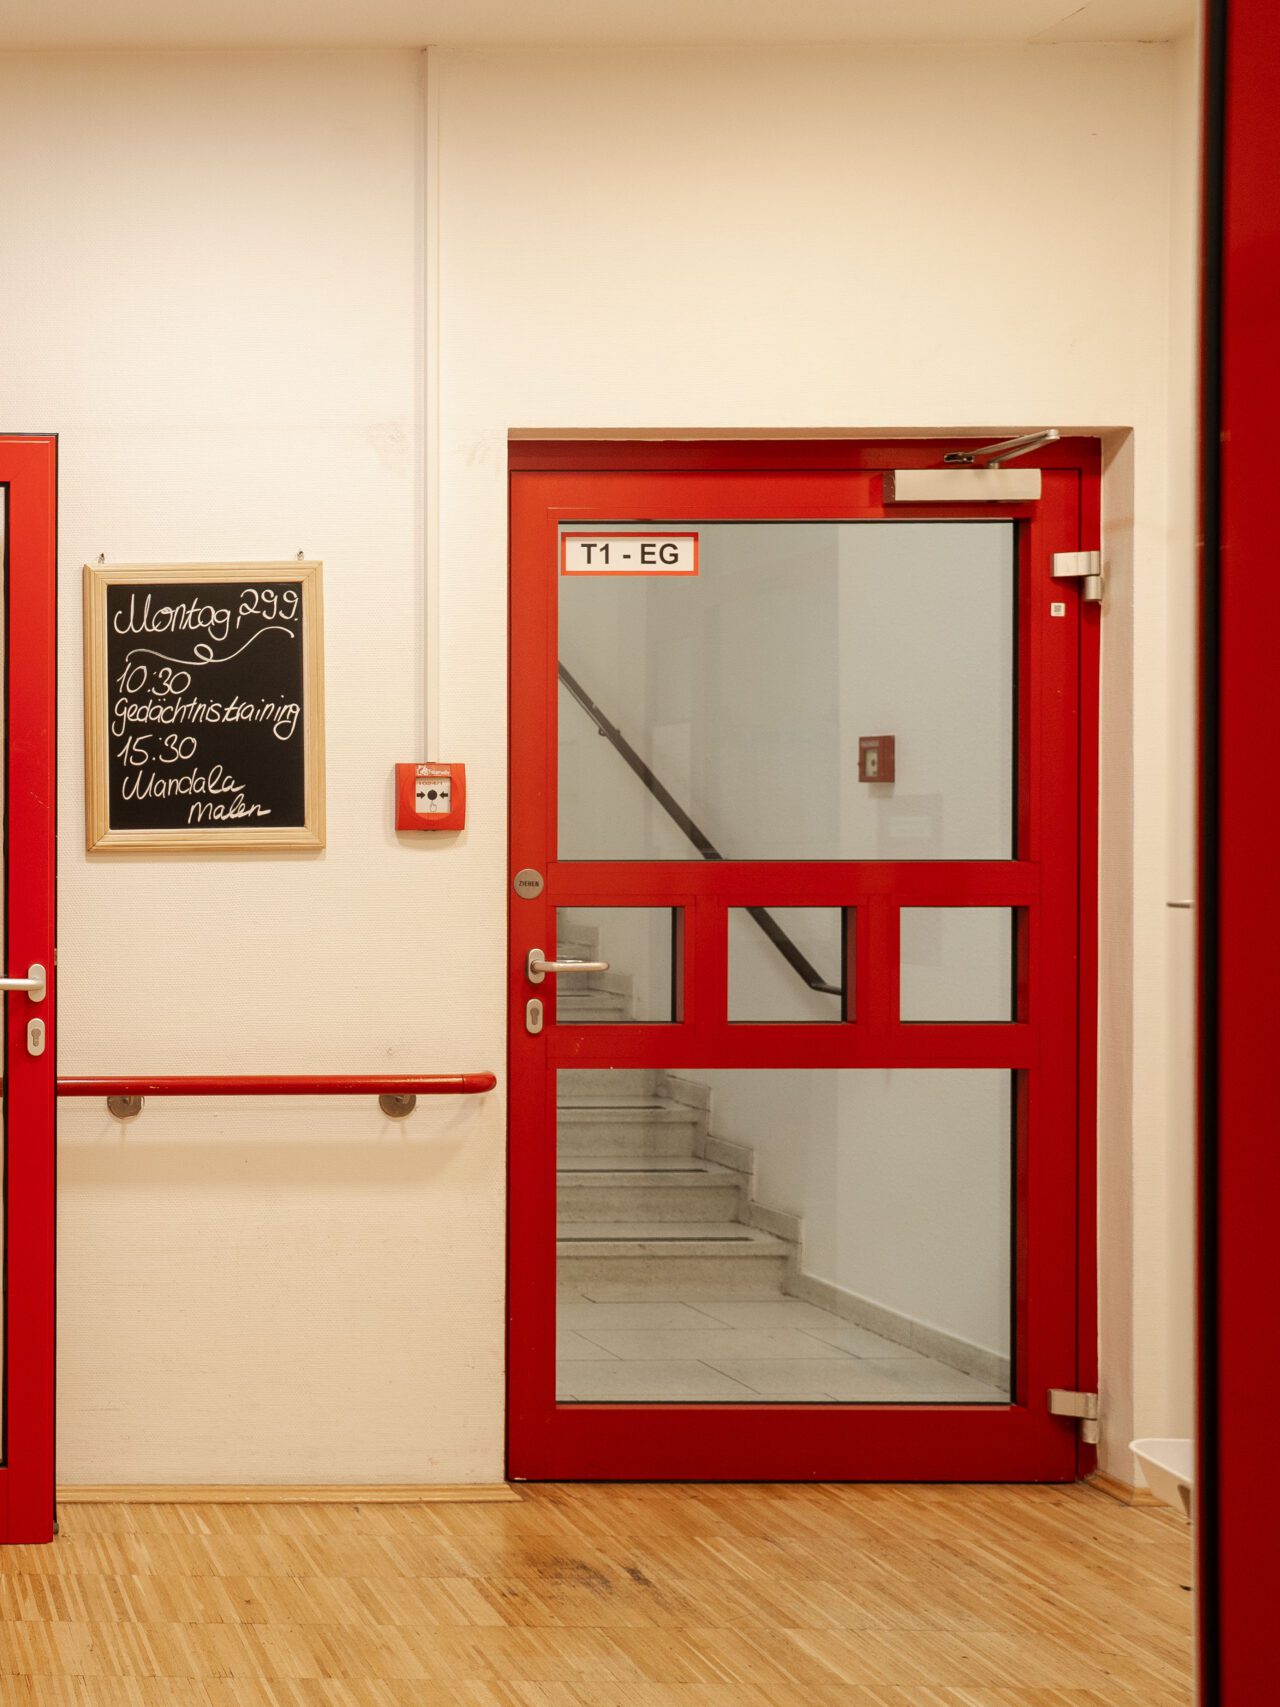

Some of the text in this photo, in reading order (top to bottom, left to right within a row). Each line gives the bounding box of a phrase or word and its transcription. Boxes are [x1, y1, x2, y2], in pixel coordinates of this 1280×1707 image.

[580, 543, 610, 565] T1
[640, 543, 679, 565] EG
[114, 593, 241, 641] Montag,
[116, 662, 192, 696] 10:30
[117, 733, 198, 767] 15:30
[122, 764, 246, 801] Mandala
